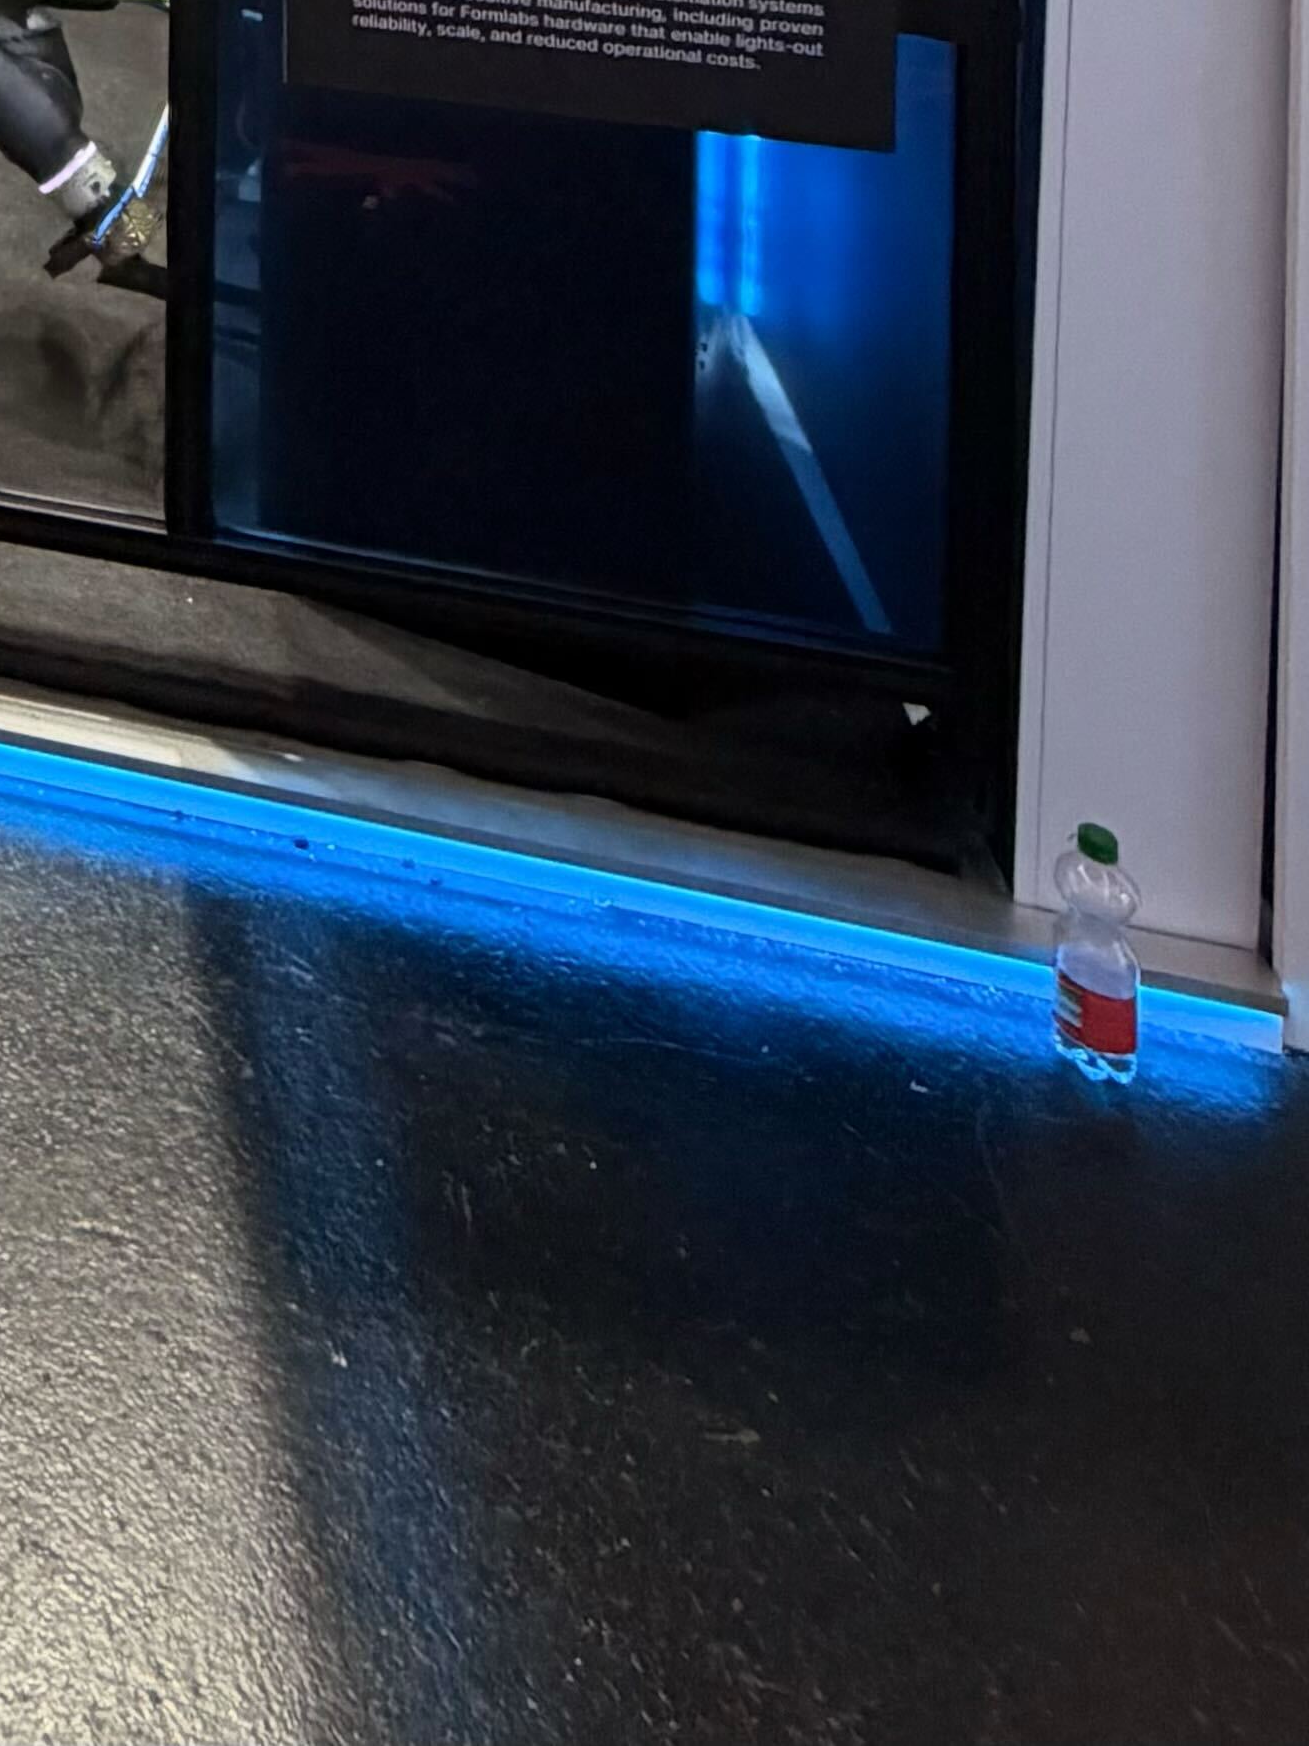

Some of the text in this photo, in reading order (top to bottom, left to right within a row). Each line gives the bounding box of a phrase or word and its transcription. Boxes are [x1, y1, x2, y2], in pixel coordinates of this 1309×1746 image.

[352, 11, 762, 71] reliability, scale, and reduced operational costs.
[432, 0, 456, 18] for
[460, 4, 539, 28] Formlabs
[543, 13, 627, 37] hardware
[630, 21, 666, 41] that
[670, 26, 731, 49] enable
[735, 33, 824, 58] lights-out
[673, 6, 755, 33] including
[759, 17, 824, 37] proven
